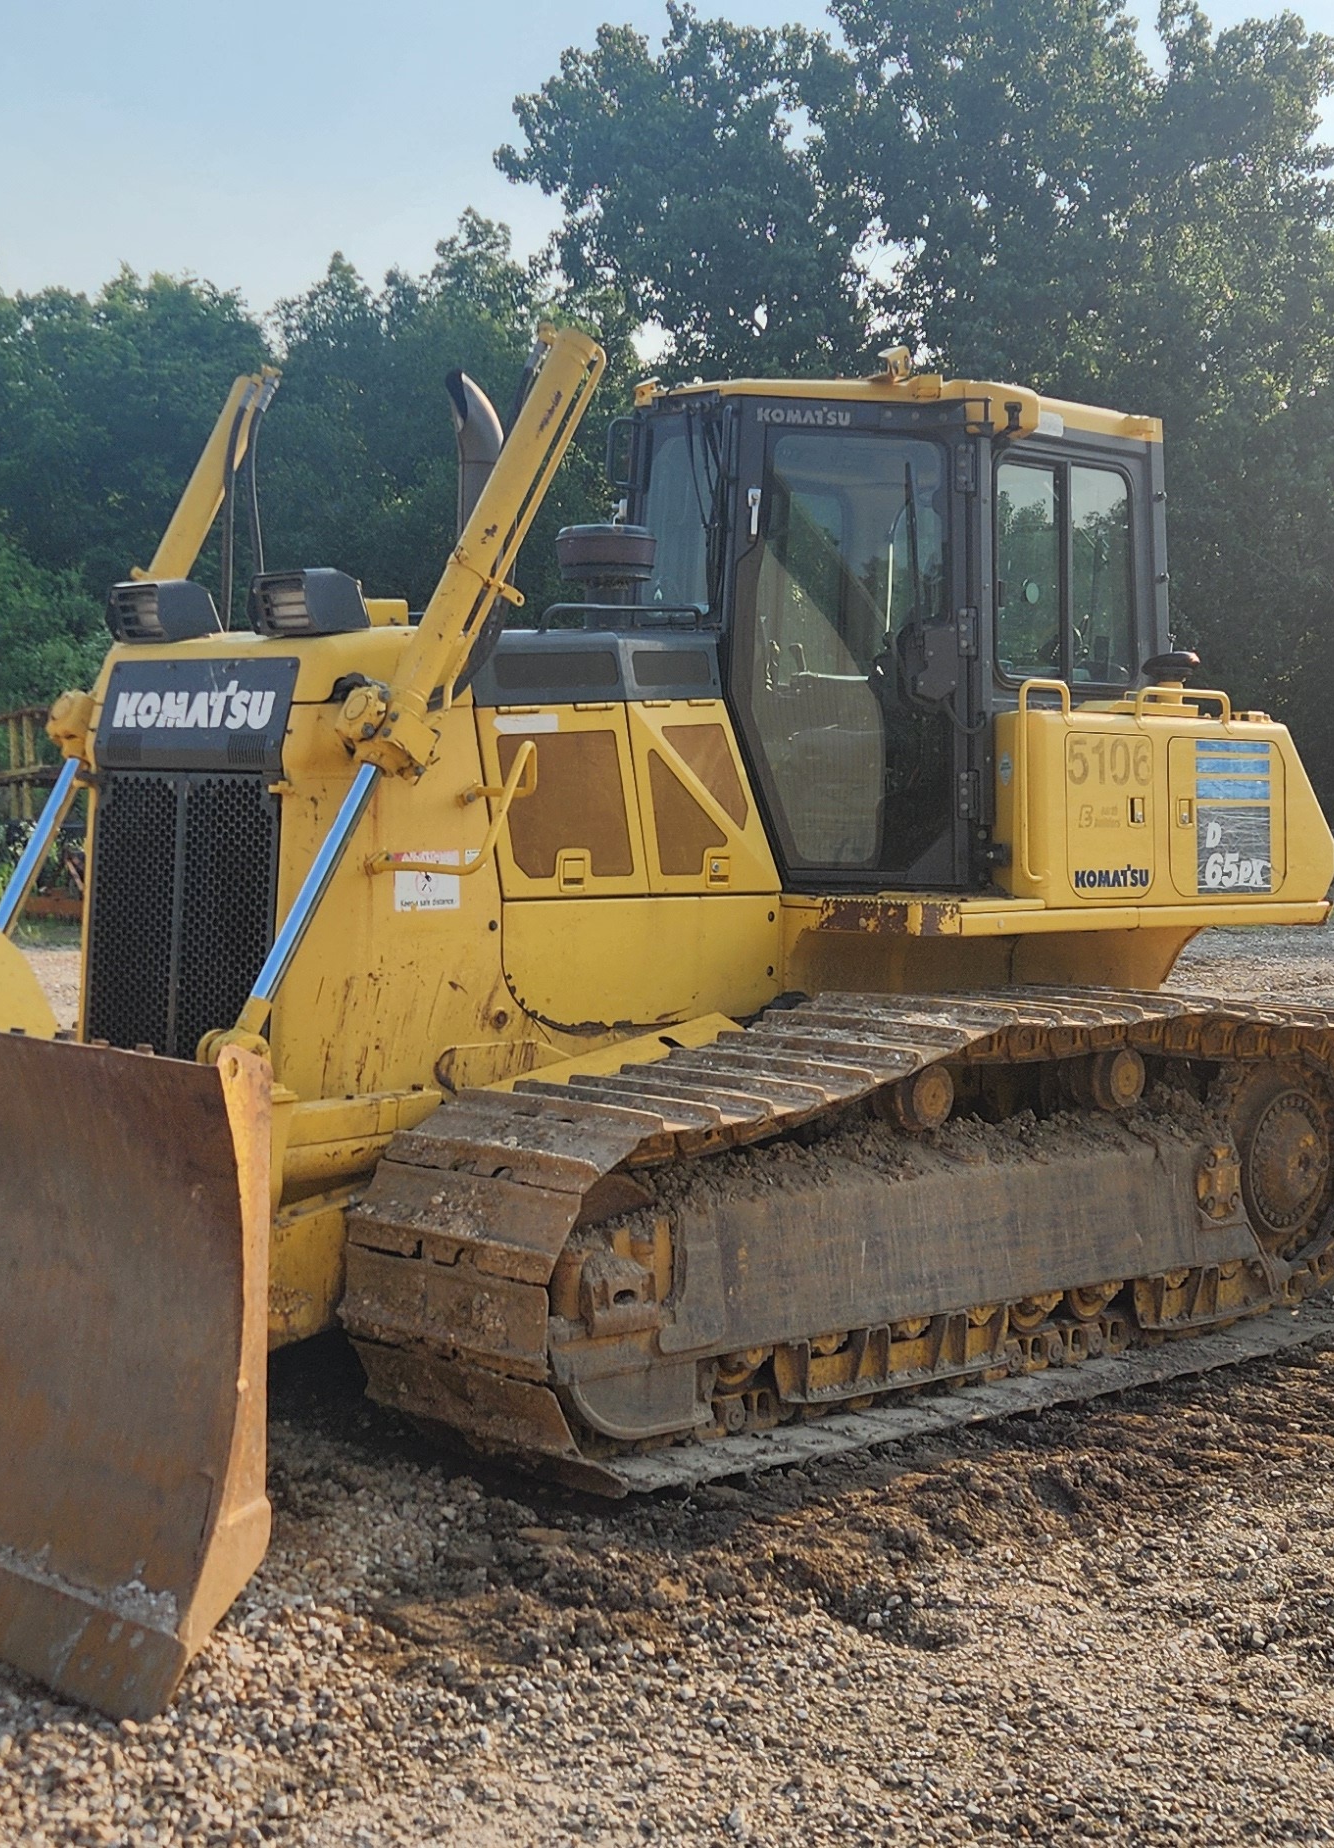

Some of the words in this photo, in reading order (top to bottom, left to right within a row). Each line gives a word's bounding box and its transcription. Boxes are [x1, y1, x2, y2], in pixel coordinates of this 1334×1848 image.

[757, 407, 851, 426] KOMATSU
[112, 680, 276, 730] KOMATSU
[1068, 738, 1152, 786] 5106
[1206, 821, 1222, 848] D
[1074, 864, 1149, 889] KOMATSU
